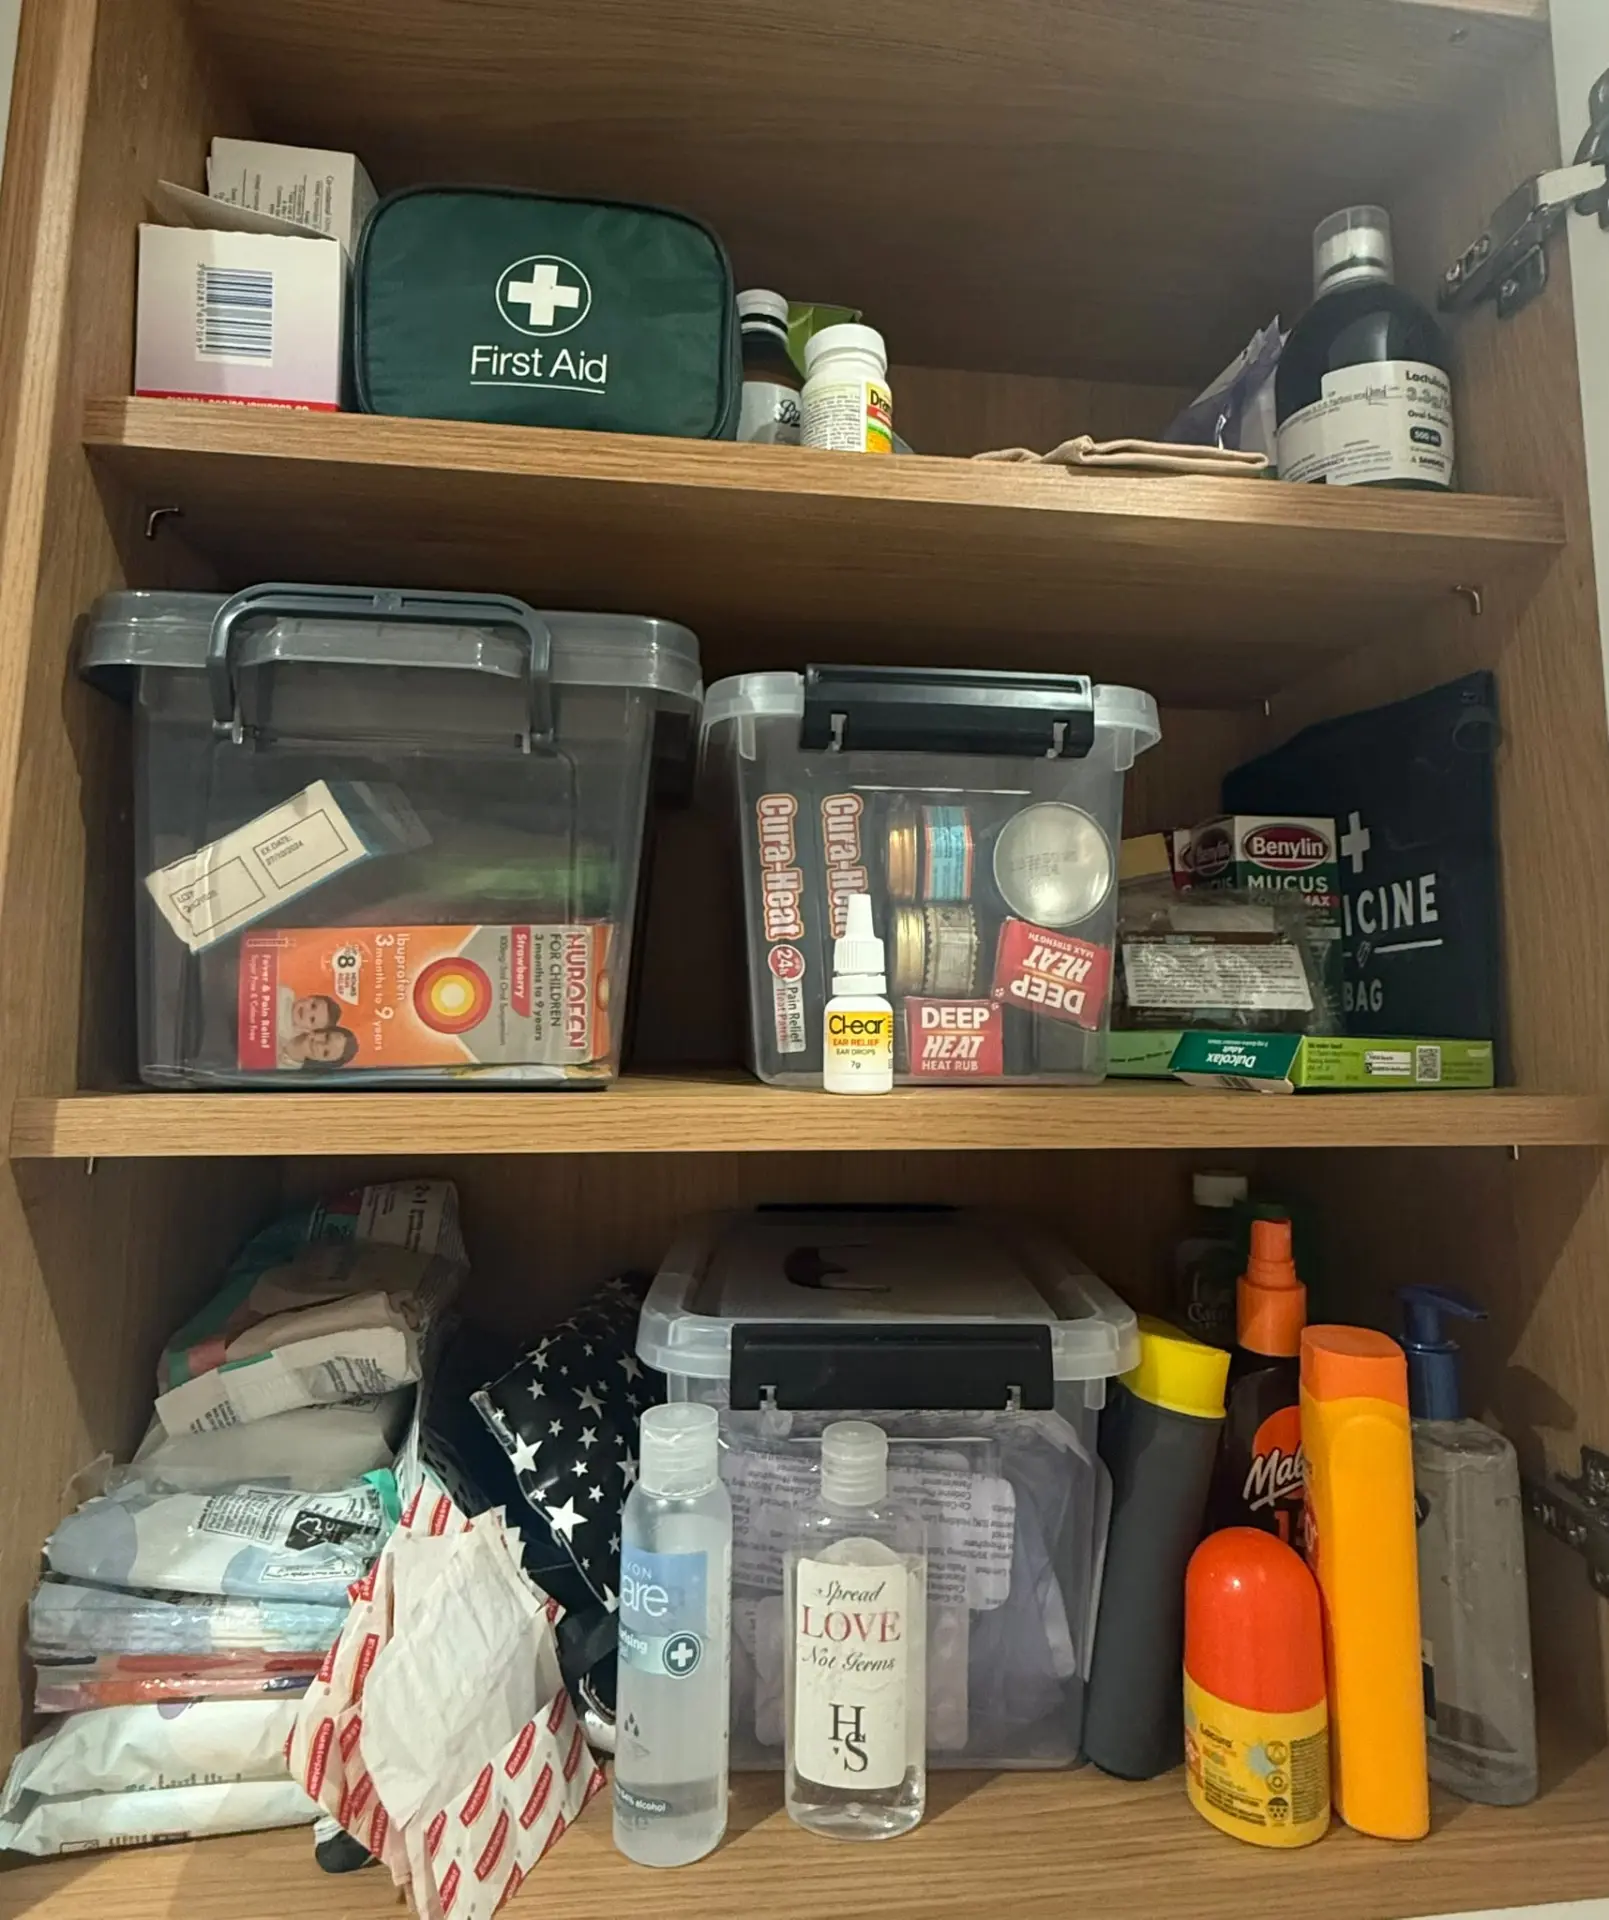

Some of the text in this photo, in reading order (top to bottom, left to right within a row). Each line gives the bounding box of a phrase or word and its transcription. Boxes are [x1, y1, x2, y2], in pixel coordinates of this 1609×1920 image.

[470, 345, 607, 384] First Aid
[1251, 835, 1327, 860] Benylin
[757, 793, 804, 941] Cura-Heat
[1247, 875, 1329, 892] MUCUS
[1344, 872, 1439, 937] ICINE
[535, 934, 544, 942] 3
[1074, 946, 1095, 958] MAX
[260, 954, 271, 981] Fever
[337, 955, 356, 969] 8
[394, 933, 410, 1001] Ibuprofen
[514, 933, 528, 999] Strawberry
[534, 944, 544, 984] months
[1022, 944, 1093, 983] HEAT
[372, 934, 394, 1051] 3 months to 9 years
[534, 987, 544, 998] to
[550, 934, 562, 1027] FOR CHILDREN
[565, 933, 588, 1049] NUROFEN
[260, 995, 271, 1017] Pain
[1010, 979, 1087, 1015] DEEP
[1344, 979, 1384, 1013] BAG
[534, 1013, 544, 1042] years
[787, 986, 802, 1043] Pain Relief
[921, 1007, 990, 1030] DEEP
[260, 1020, 271, 1049] Relief
[832, 1038, 880, 1047] EAR RELIEF
[921, 1035, 985, 1058] HEAT
[836, 1048, 850, 1056] EAR
[921, 1060, 979, 1072] HEAT RUB
[1205, 1052, 1257, 1069] Dulcolax
[621, 1574, 669, 1617] are
[818, 1581, 886, 1605] Spread
[801, 1605, 901, 1644] LOVE
[802, 1646, 896, 1673] Not Germs
[308, 1720, 334, 1798] Elastoplast
[635, 1799, 666, 1812] alcohol
